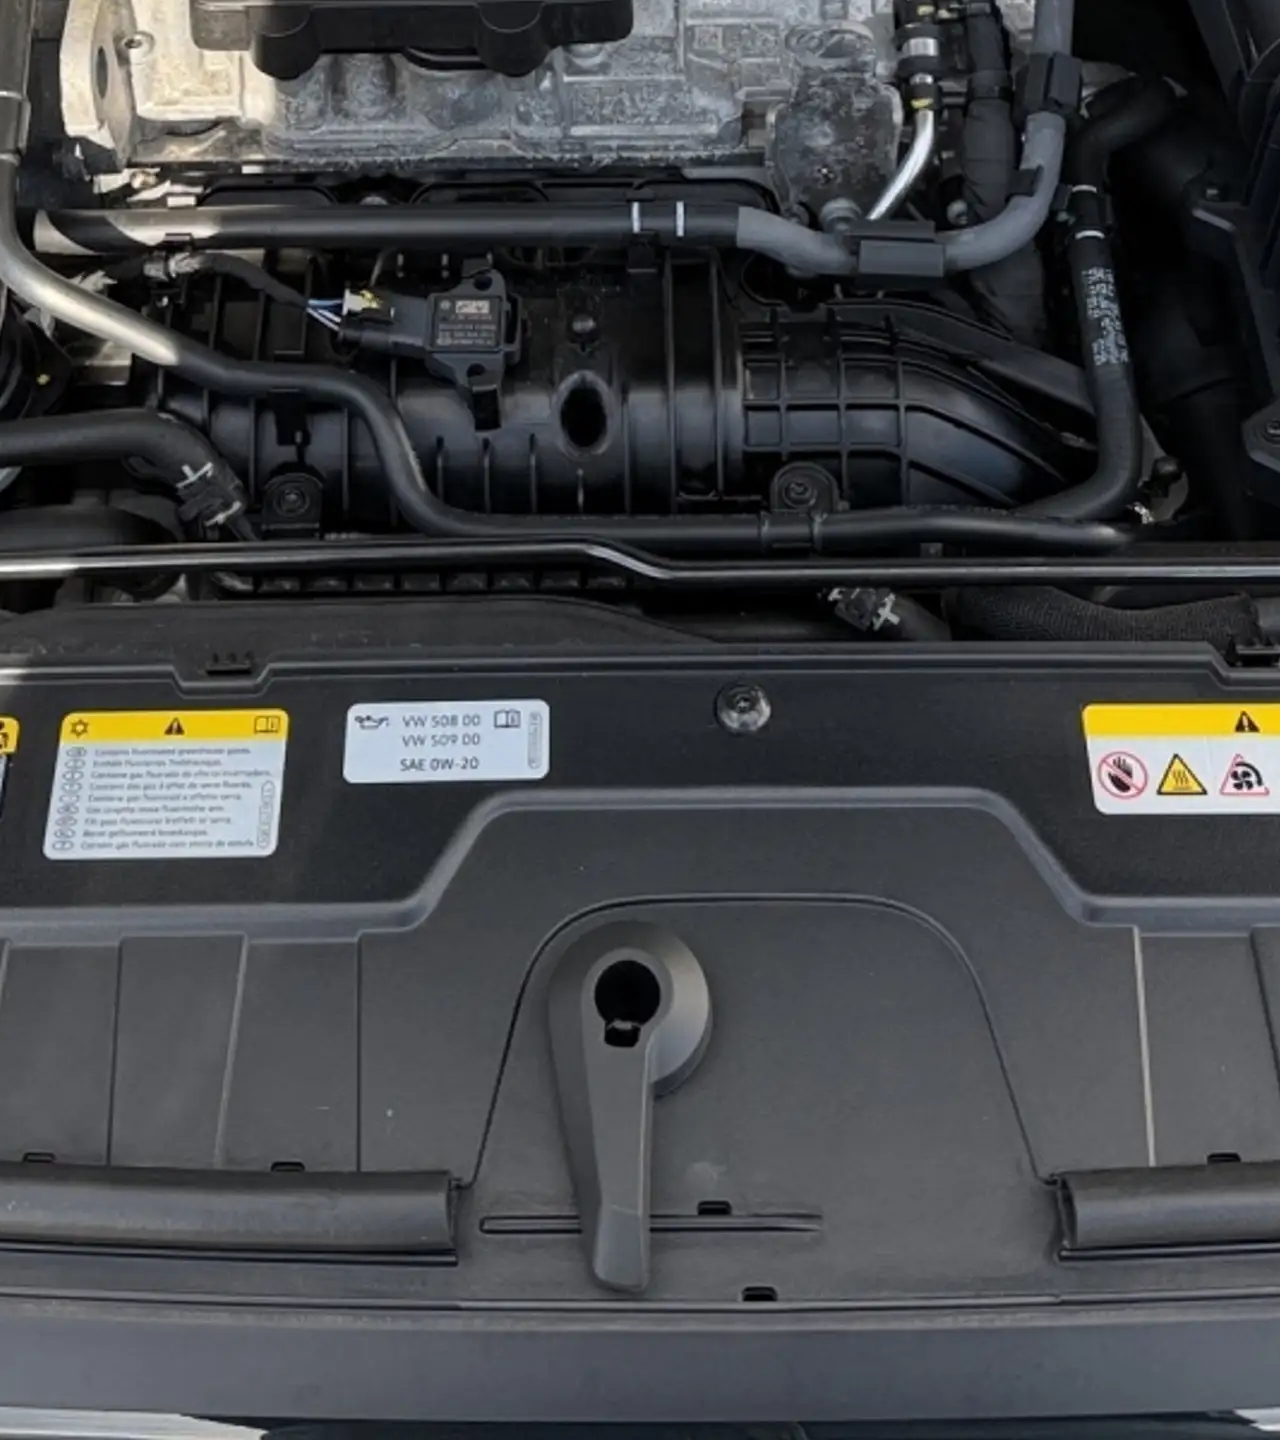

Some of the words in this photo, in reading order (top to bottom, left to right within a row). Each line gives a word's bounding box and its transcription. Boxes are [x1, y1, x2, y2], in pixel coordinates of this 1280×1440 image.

[402, 714, 427, 728] VW
[431, 714, 458, 729] 508
[462, 713, 482, 728] 00
[402, 734, 427, 748] VW
[431, 734, 458, 748] 509
[462, 733, 481, 747] 00
[400, 758, 426, 772] SAE
[429, 757, 480, 771] 0W-20
